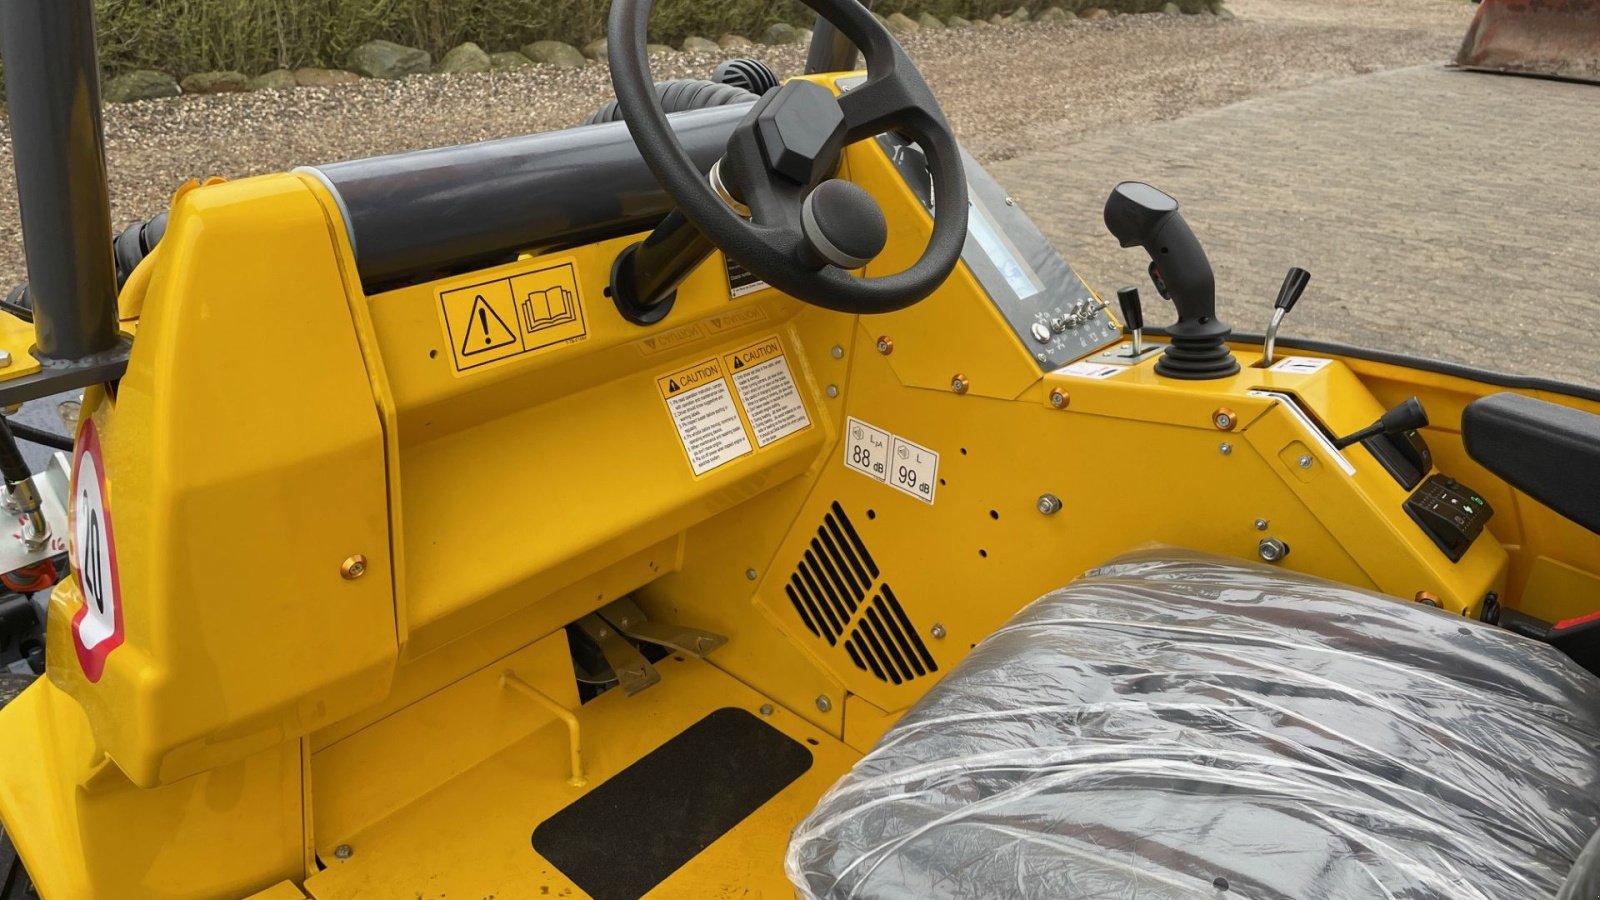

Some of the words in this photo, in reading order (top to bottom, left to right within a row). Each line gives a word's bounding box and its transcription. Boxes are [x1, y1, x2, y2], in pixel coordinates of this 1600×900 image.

[743, 343, 778, 362] CAUTION
[680, 364, 718, 386] CAUTION
[853, 445, 870, 467] 88
[873, 462, 884, 474] dB
[916, 454, 922, 463] L
[898, 466, 916, 487] 99
[919, 482, 930, 494] dB
[83, 488, 104, 614] 20
